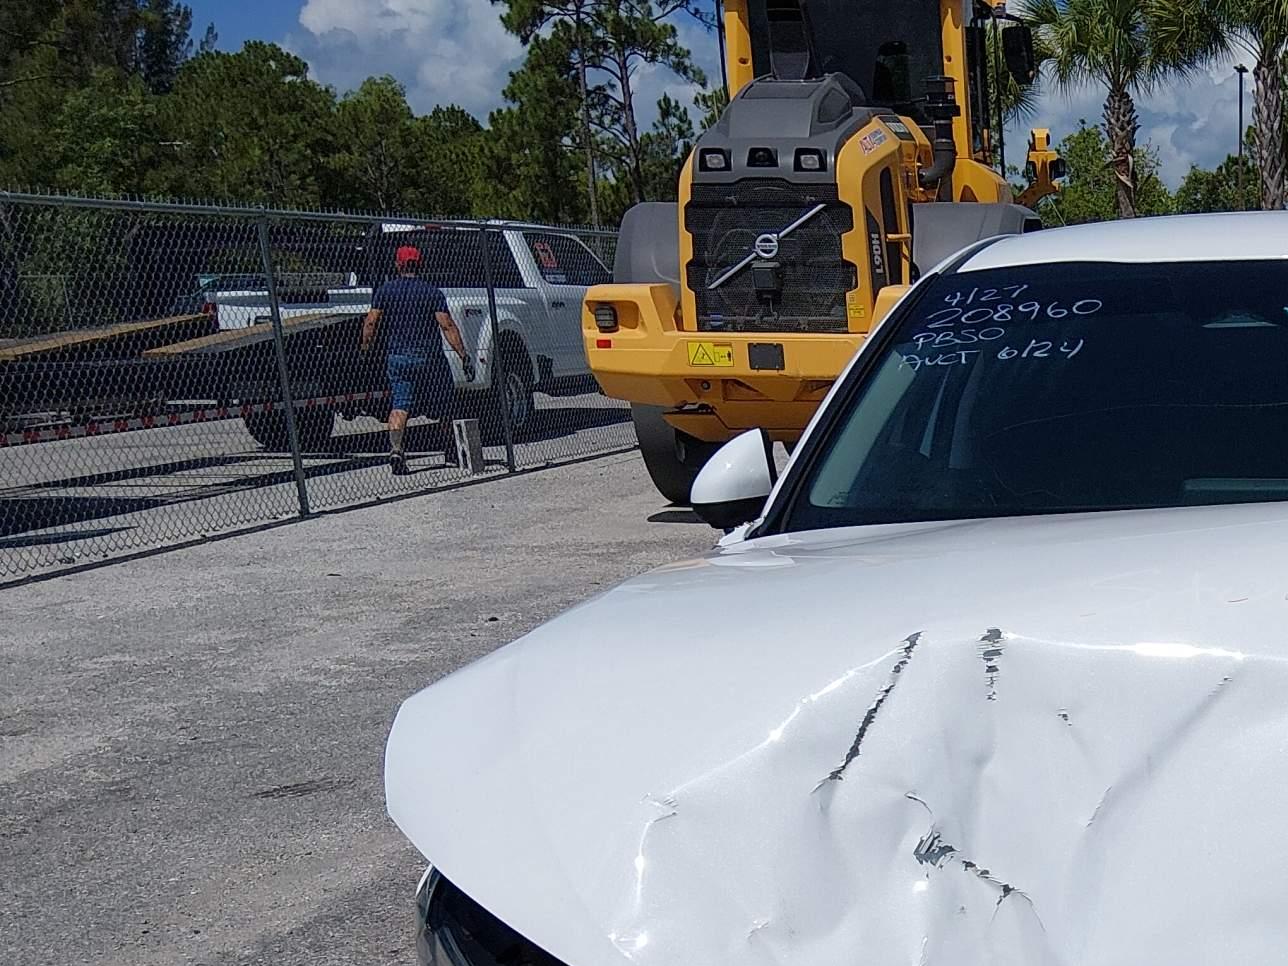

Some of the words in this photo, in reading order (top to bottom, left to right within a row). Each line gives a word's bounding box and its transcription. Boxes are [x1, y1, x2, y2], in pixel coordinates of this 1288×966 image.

[871, 233, 884, 274] L90H
[925, 299, 1103, 328] 208960
[996, 339, 1084, 360] 6/24
